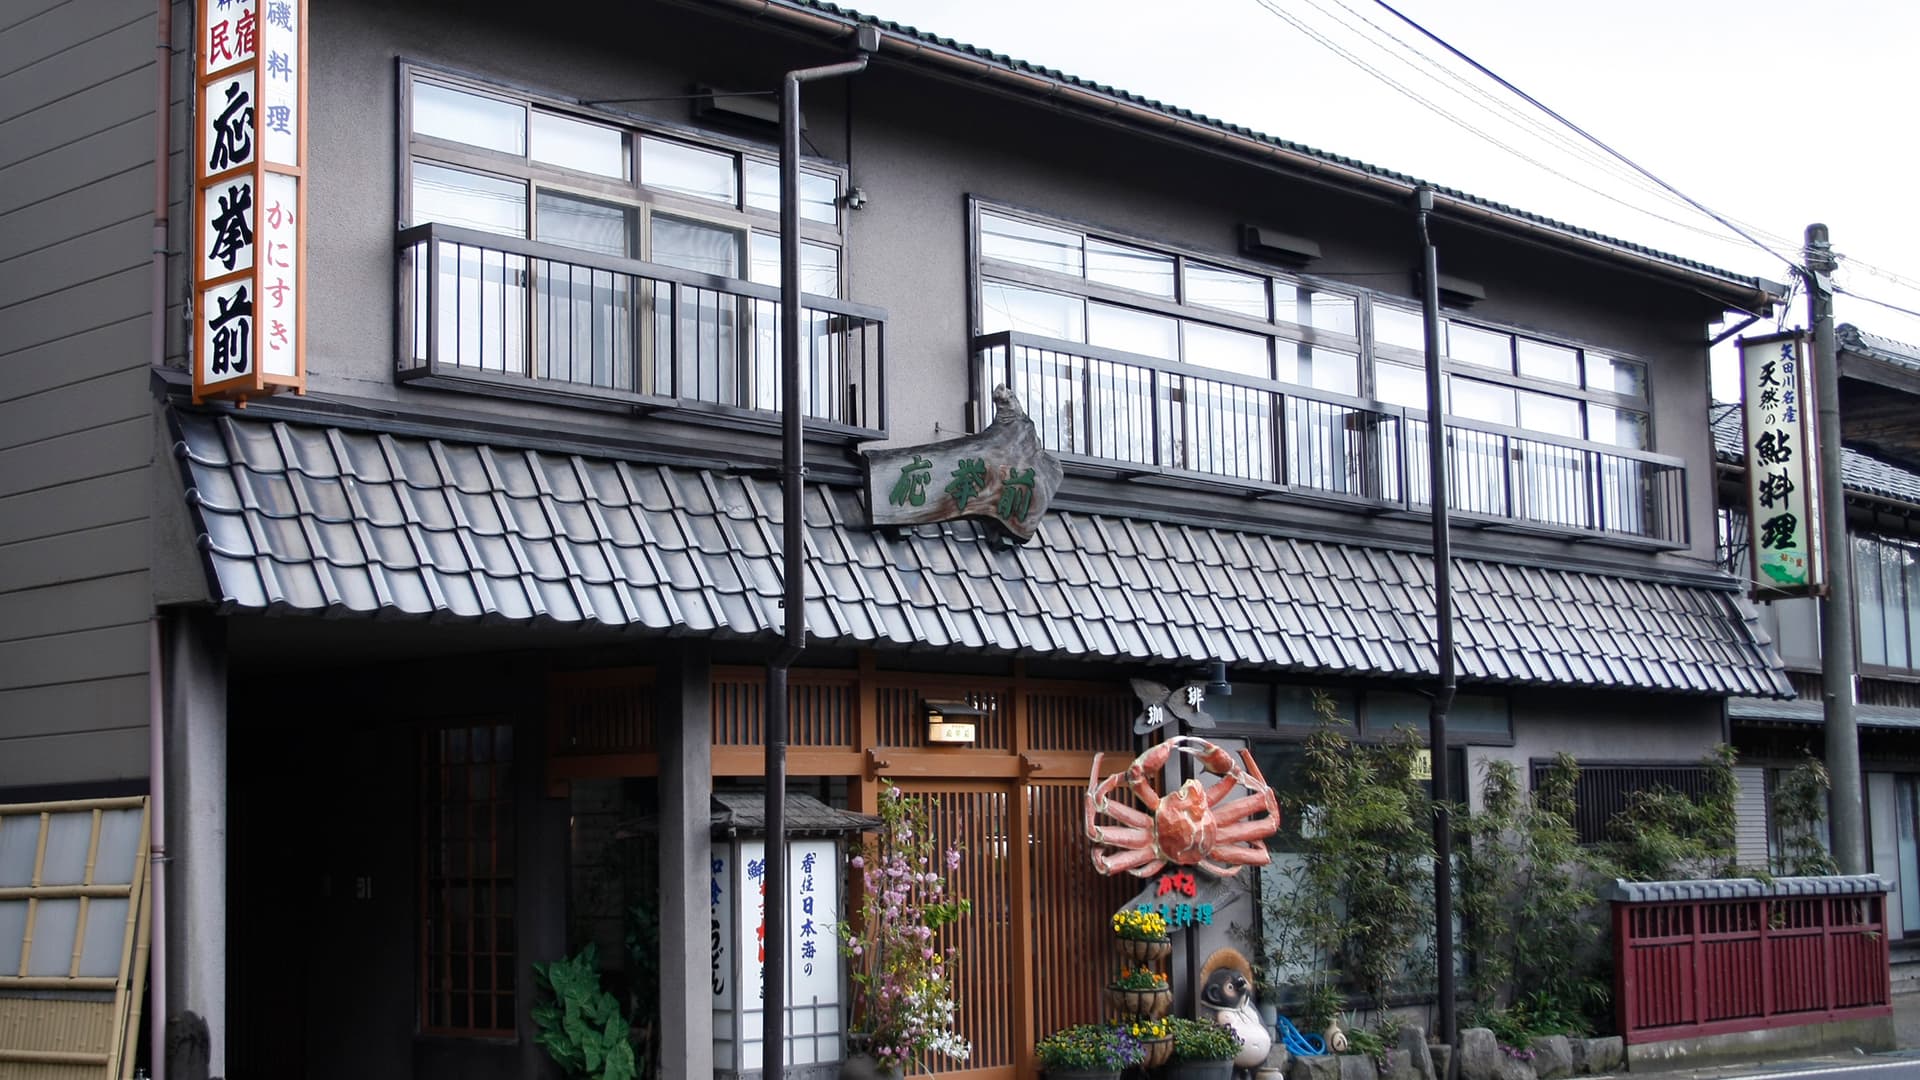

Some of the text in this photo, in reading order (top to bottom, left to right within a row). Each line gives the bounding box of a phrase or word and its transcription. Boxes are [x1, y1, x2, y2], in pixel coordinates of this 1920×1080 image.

[210, 8, 255, 65] 民宿
[266, 2, 293, 135] 磯料理
[209, 82, 253, 374] 応挙前
[264, 200, 293, 350] かにすき
[1780, 343, 1797, 423] 矢田川名産
[889, 455, 1036, 522] 応挙前
